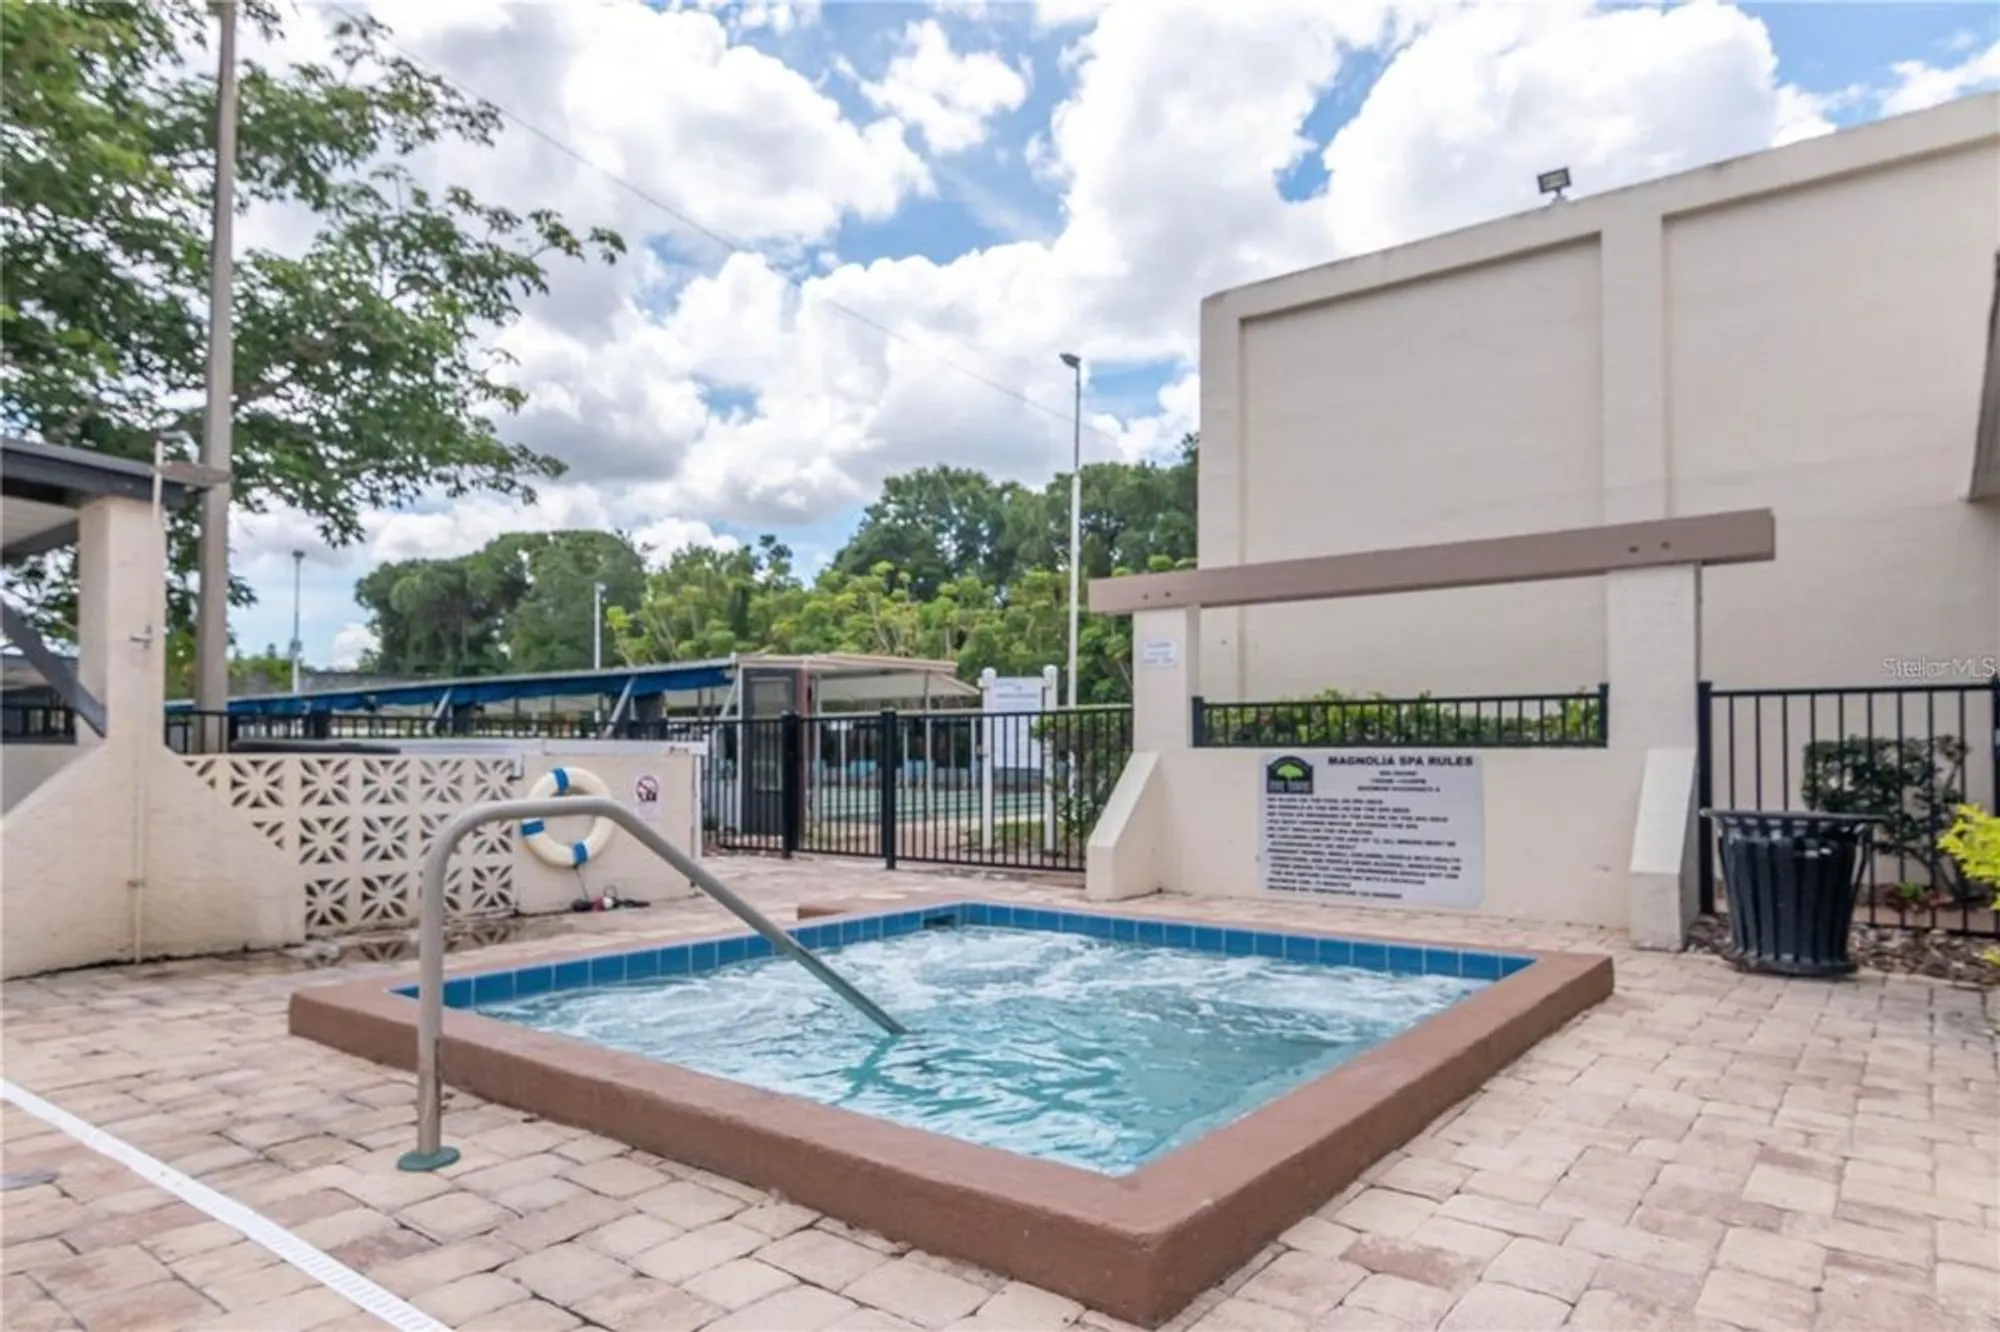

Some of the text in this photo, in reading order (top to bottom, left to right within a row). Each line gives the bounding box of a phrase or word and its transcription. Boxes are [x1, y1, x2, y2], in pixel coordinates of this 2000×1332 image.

[1328, 755, 1474, 767] MAGNOLIA SPA RULES
